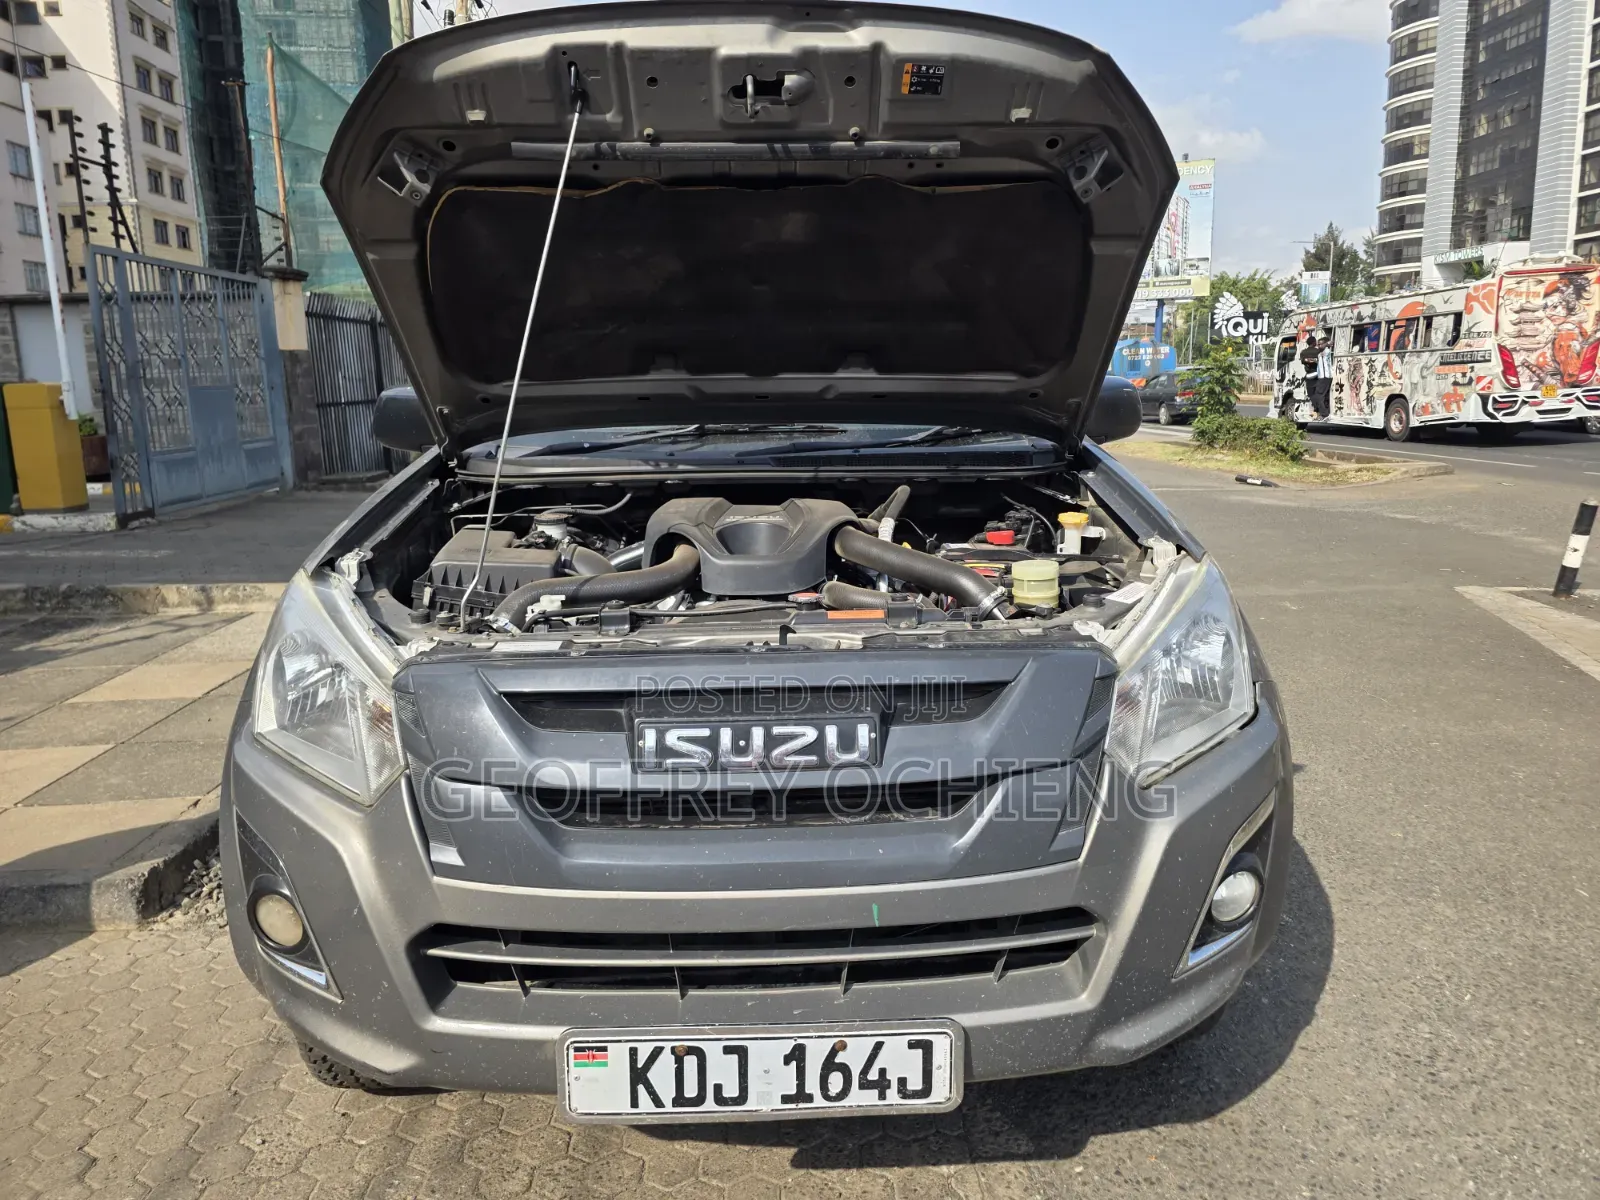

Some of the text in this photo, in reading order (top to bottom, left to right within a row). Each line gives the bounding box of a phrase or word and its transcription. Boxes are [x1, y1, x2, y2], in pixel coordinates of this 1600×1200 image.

[1122, 346, 1145, 356] CLEAN
[642, 723, 871, 769] ISUZU
[628, 1043, 749, 1109] KDJ
[780, 1038, 934, 1105] 164J
